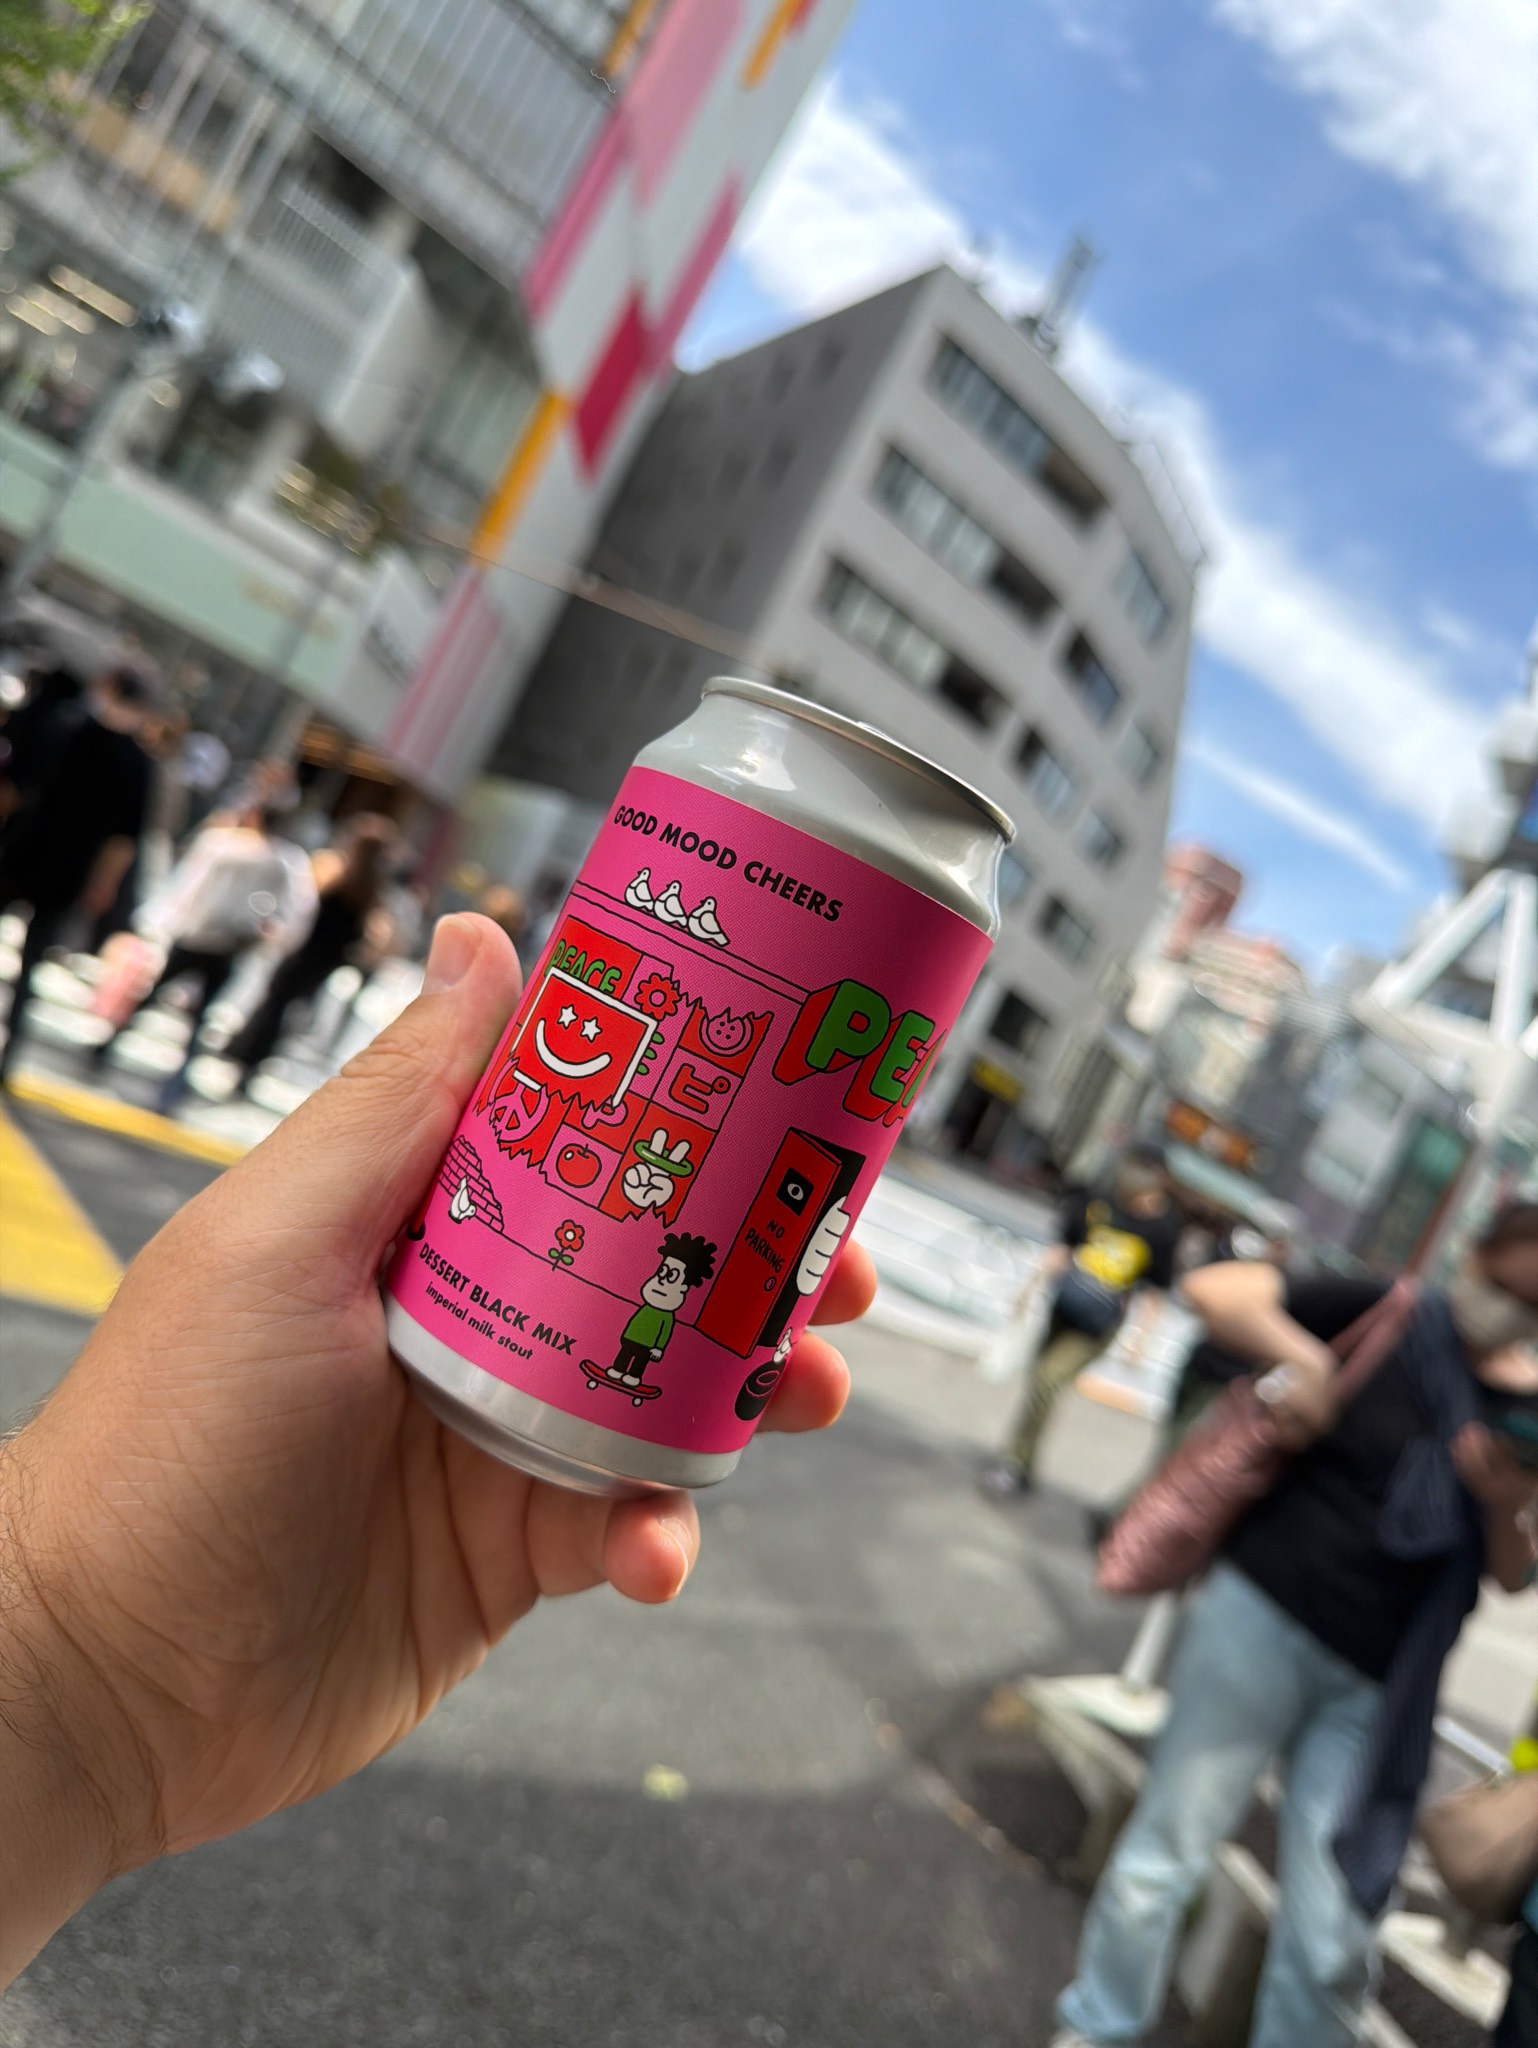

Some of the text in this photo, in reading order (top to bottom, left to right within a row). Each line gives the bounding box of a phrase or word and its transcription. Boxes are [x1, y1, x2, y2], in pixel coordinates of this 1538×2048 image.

[614, 806, 843, 922] GOOD MOOD CHEERS
[744, 1227, 785, 1274] PARKING
[766, 1220, 785, 1239] NO
[419, 1243, 578, 1356] DESSERT BLACK MIX
[425, 1281, 533, 1360] imperial milk stout
